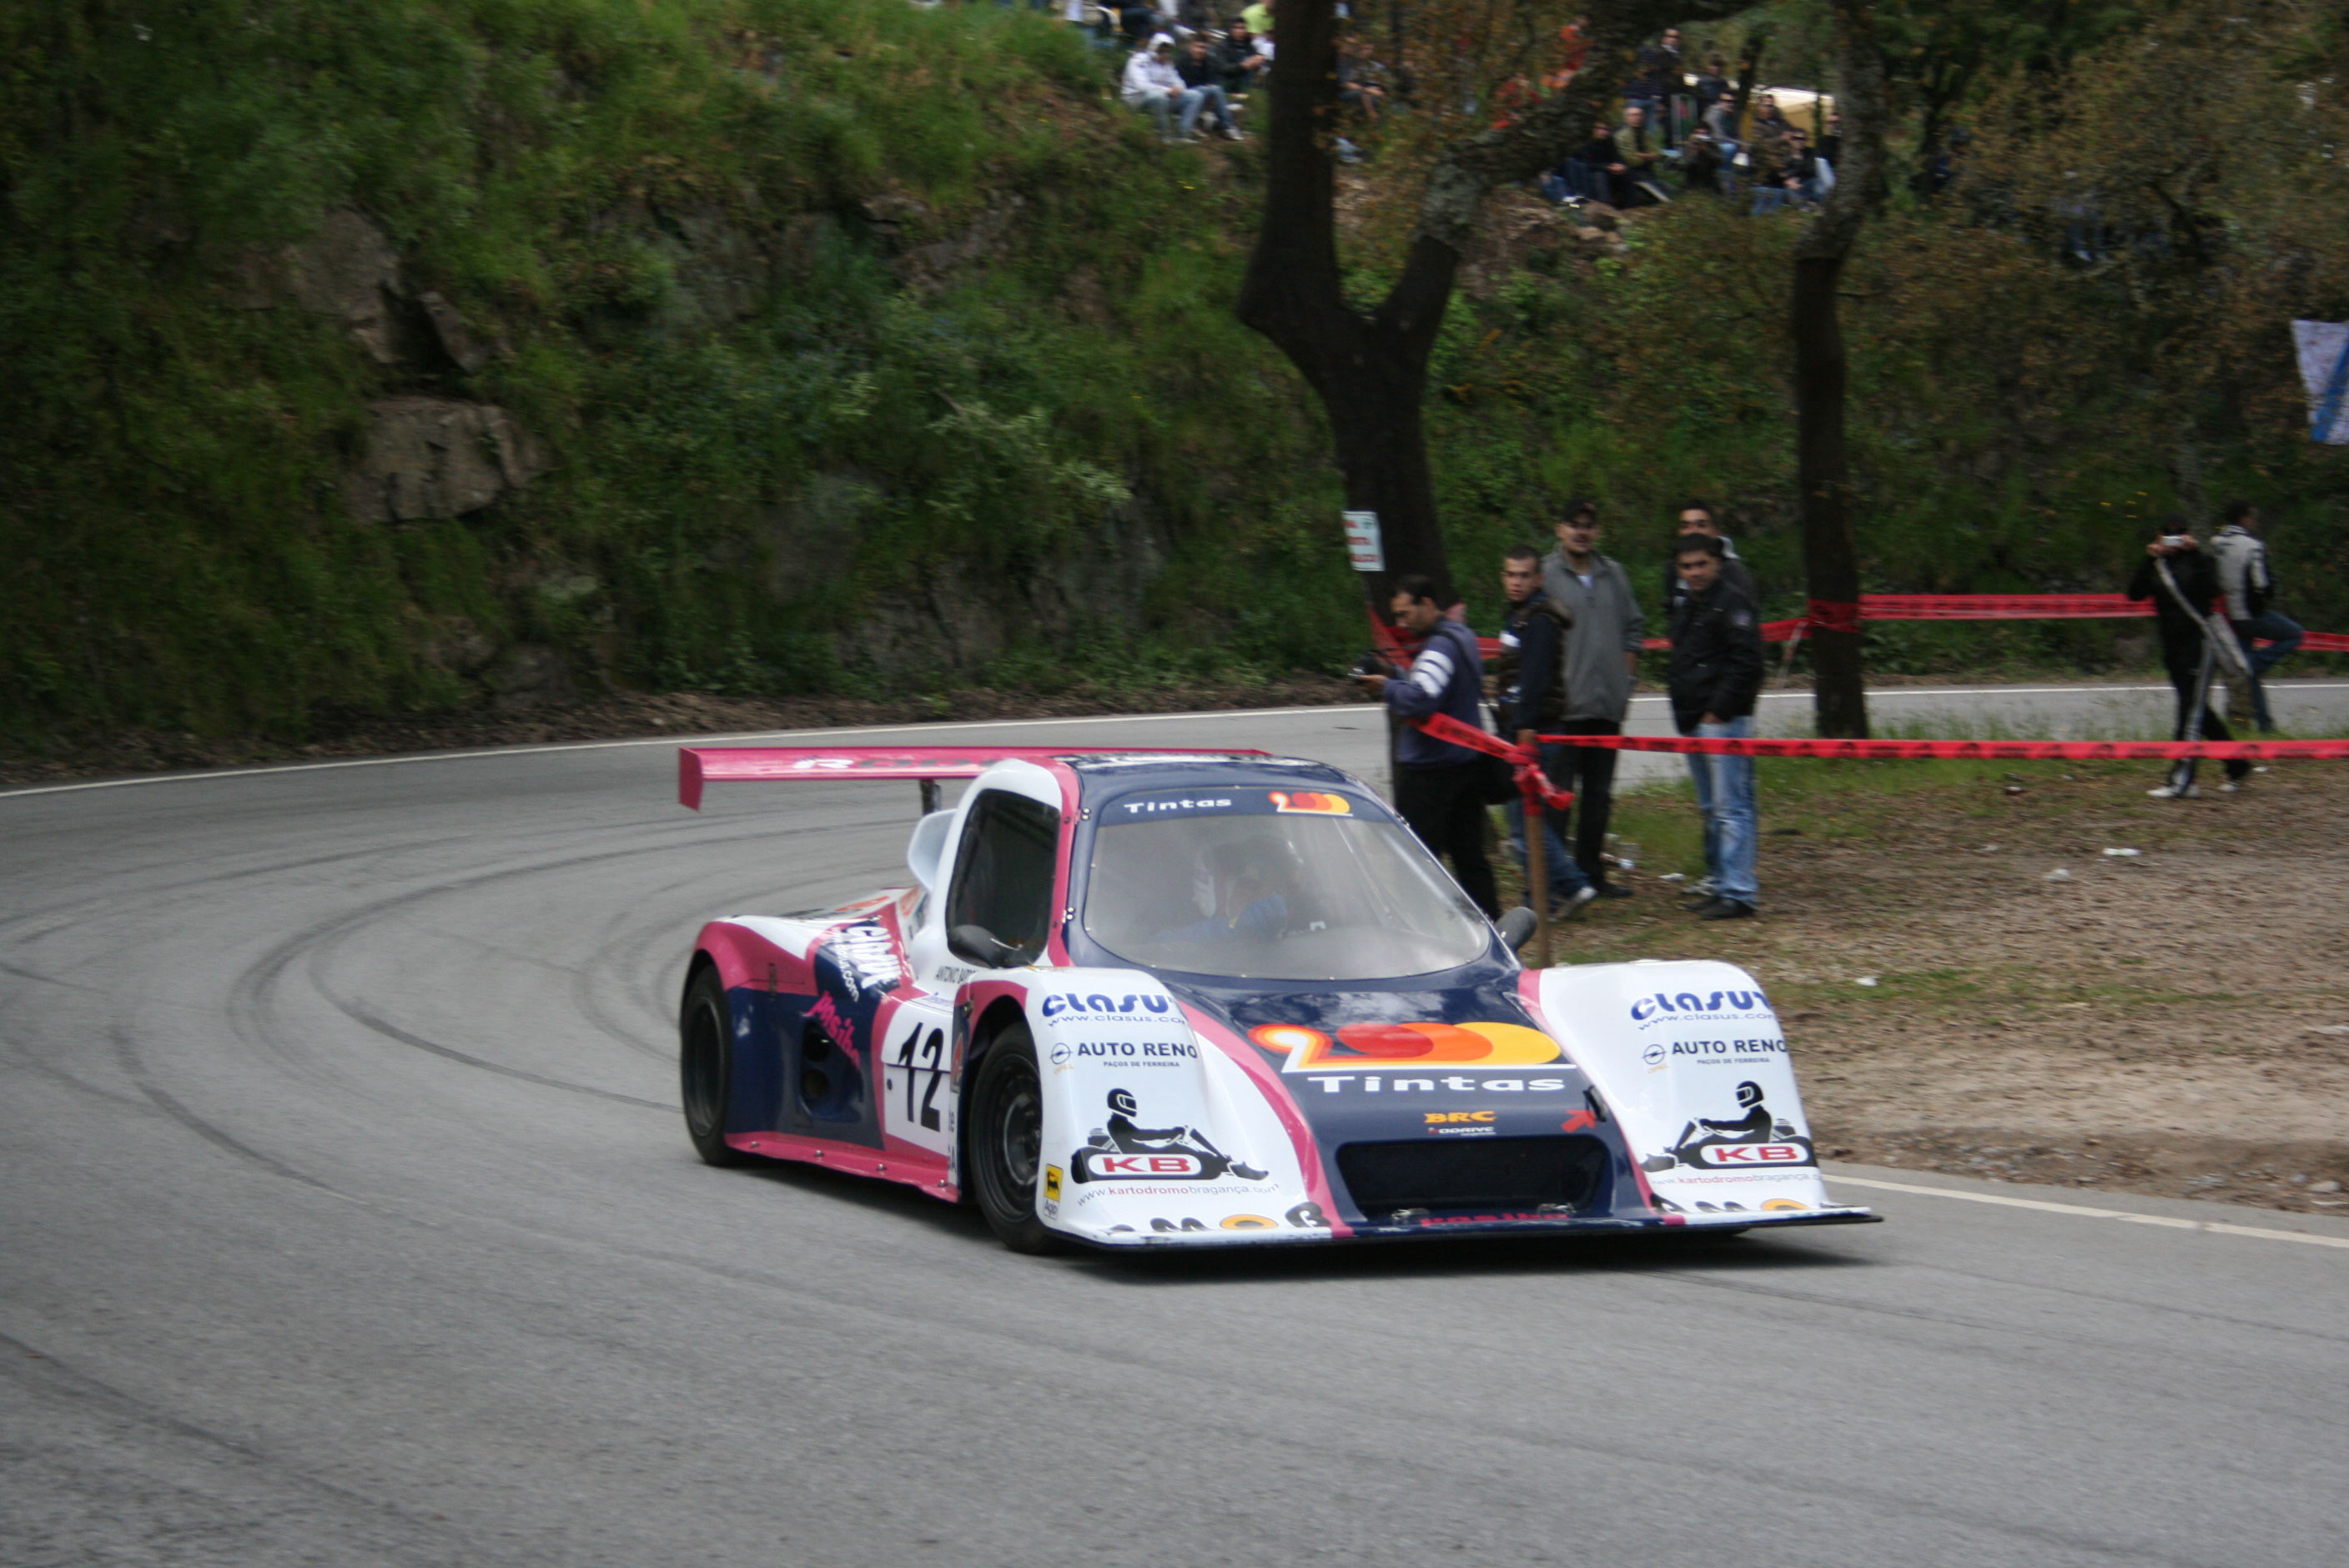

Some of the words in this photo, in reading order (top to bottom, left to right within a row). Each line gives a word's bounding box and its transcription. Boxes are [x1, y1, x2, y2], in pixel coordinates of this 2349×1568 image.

[1124, 797, 1232, 814] Tintas
[1077, 1043, 1135, 1056] AUTO
[1143, 1043, 1198, 1058] RENO
[1672, 1040, 1726, 1055] AUTO
[898, 1022, 944, 1133] 12
[1307, 1076, 1565, 1093] Tintas
[1424, 1111, 1497, 1123] BRC
[1714, 1145, 1798, 1162] KB
[1101, 1156, 1191, 1173] KB
